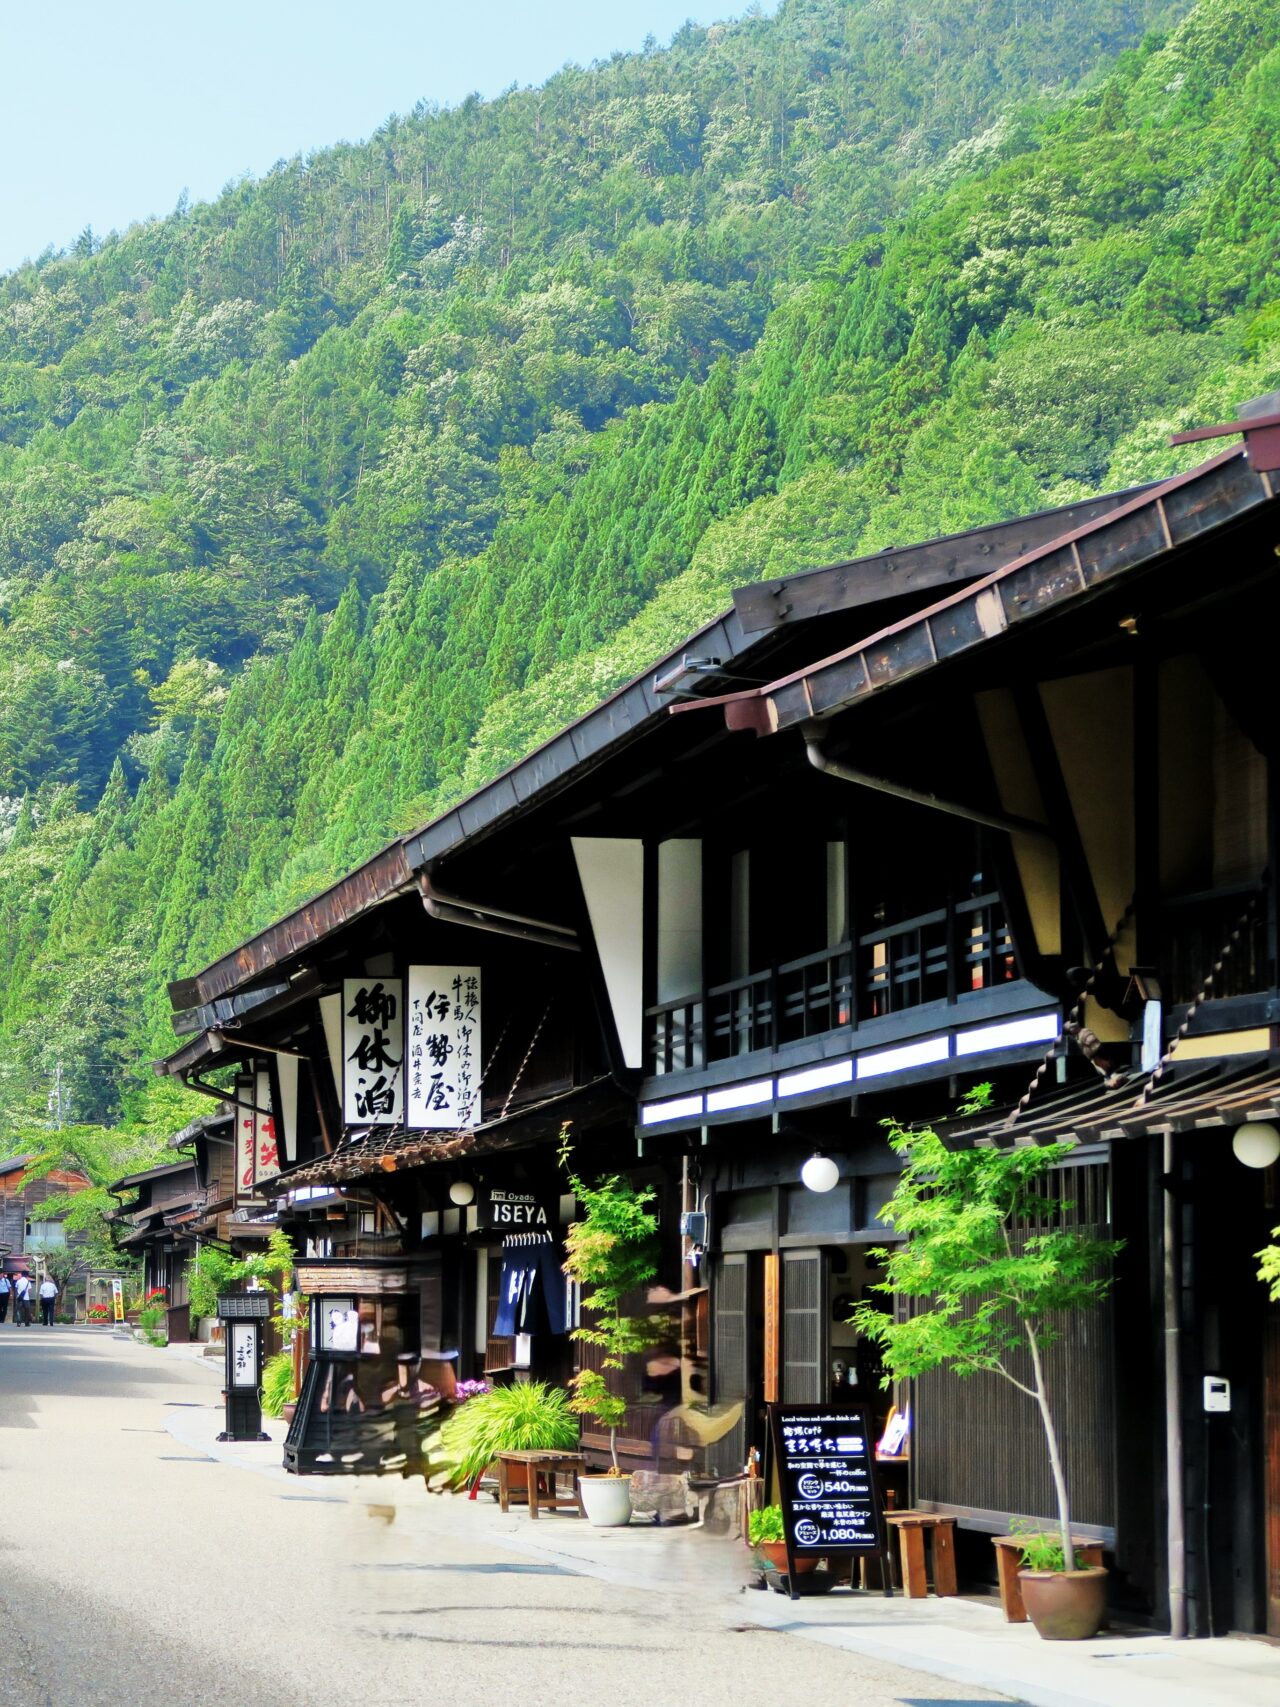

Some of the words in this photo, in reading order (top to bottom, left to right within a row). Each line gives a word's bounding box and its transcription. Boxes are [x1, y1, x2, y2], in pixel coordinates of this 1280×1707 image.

[347, 982, 404, 1119] 御休泊
[425, 989, 455, 1112] 伊勢屋
[493, 1204, 548, 1225] ISEYA
